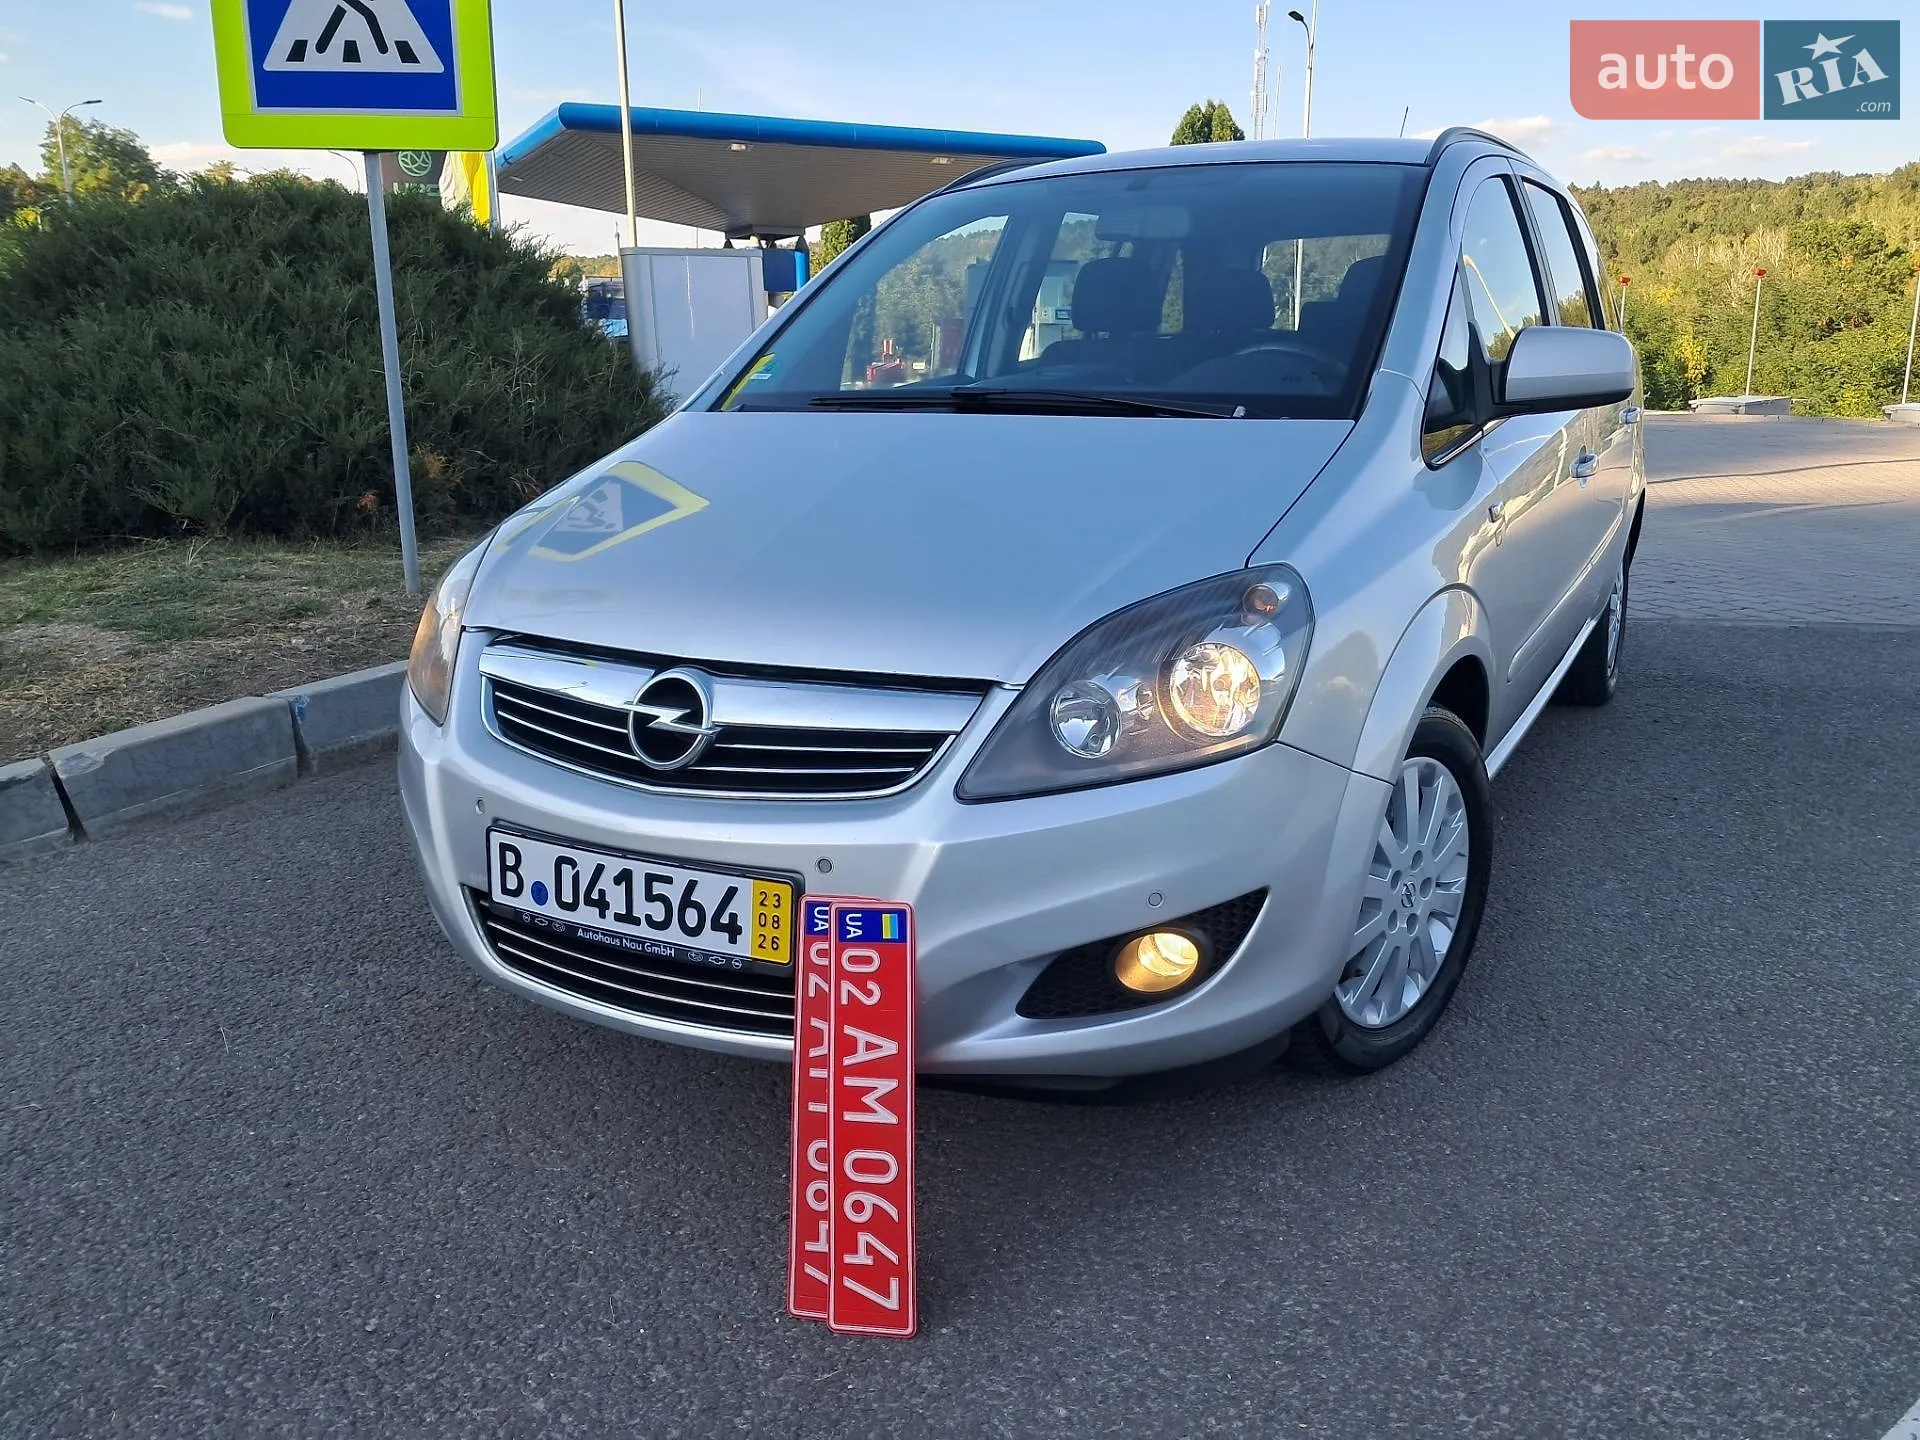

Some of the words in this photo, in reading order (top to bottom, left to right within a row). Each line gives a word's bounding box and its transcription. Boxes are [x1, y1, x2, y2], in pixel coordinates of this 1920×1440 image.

[498, 842, 524, 898] B
[554, 855, 743, 945] 041564
[758, 891, 781, 909] 23
[758, 912, 780, 930] 08
[845, 913, 863, 939] UA
[577, 928, 620, 946] Autohaus
[622, 937, 643, 951] Nau
[644, 942, 675, 958] GmbH
[757, 933, 780, 951] 26
[840, 948, 882, 1006] 02
[843, 1024, 899, 1125] AM
[842, 1149, 900, 1311] 0647
